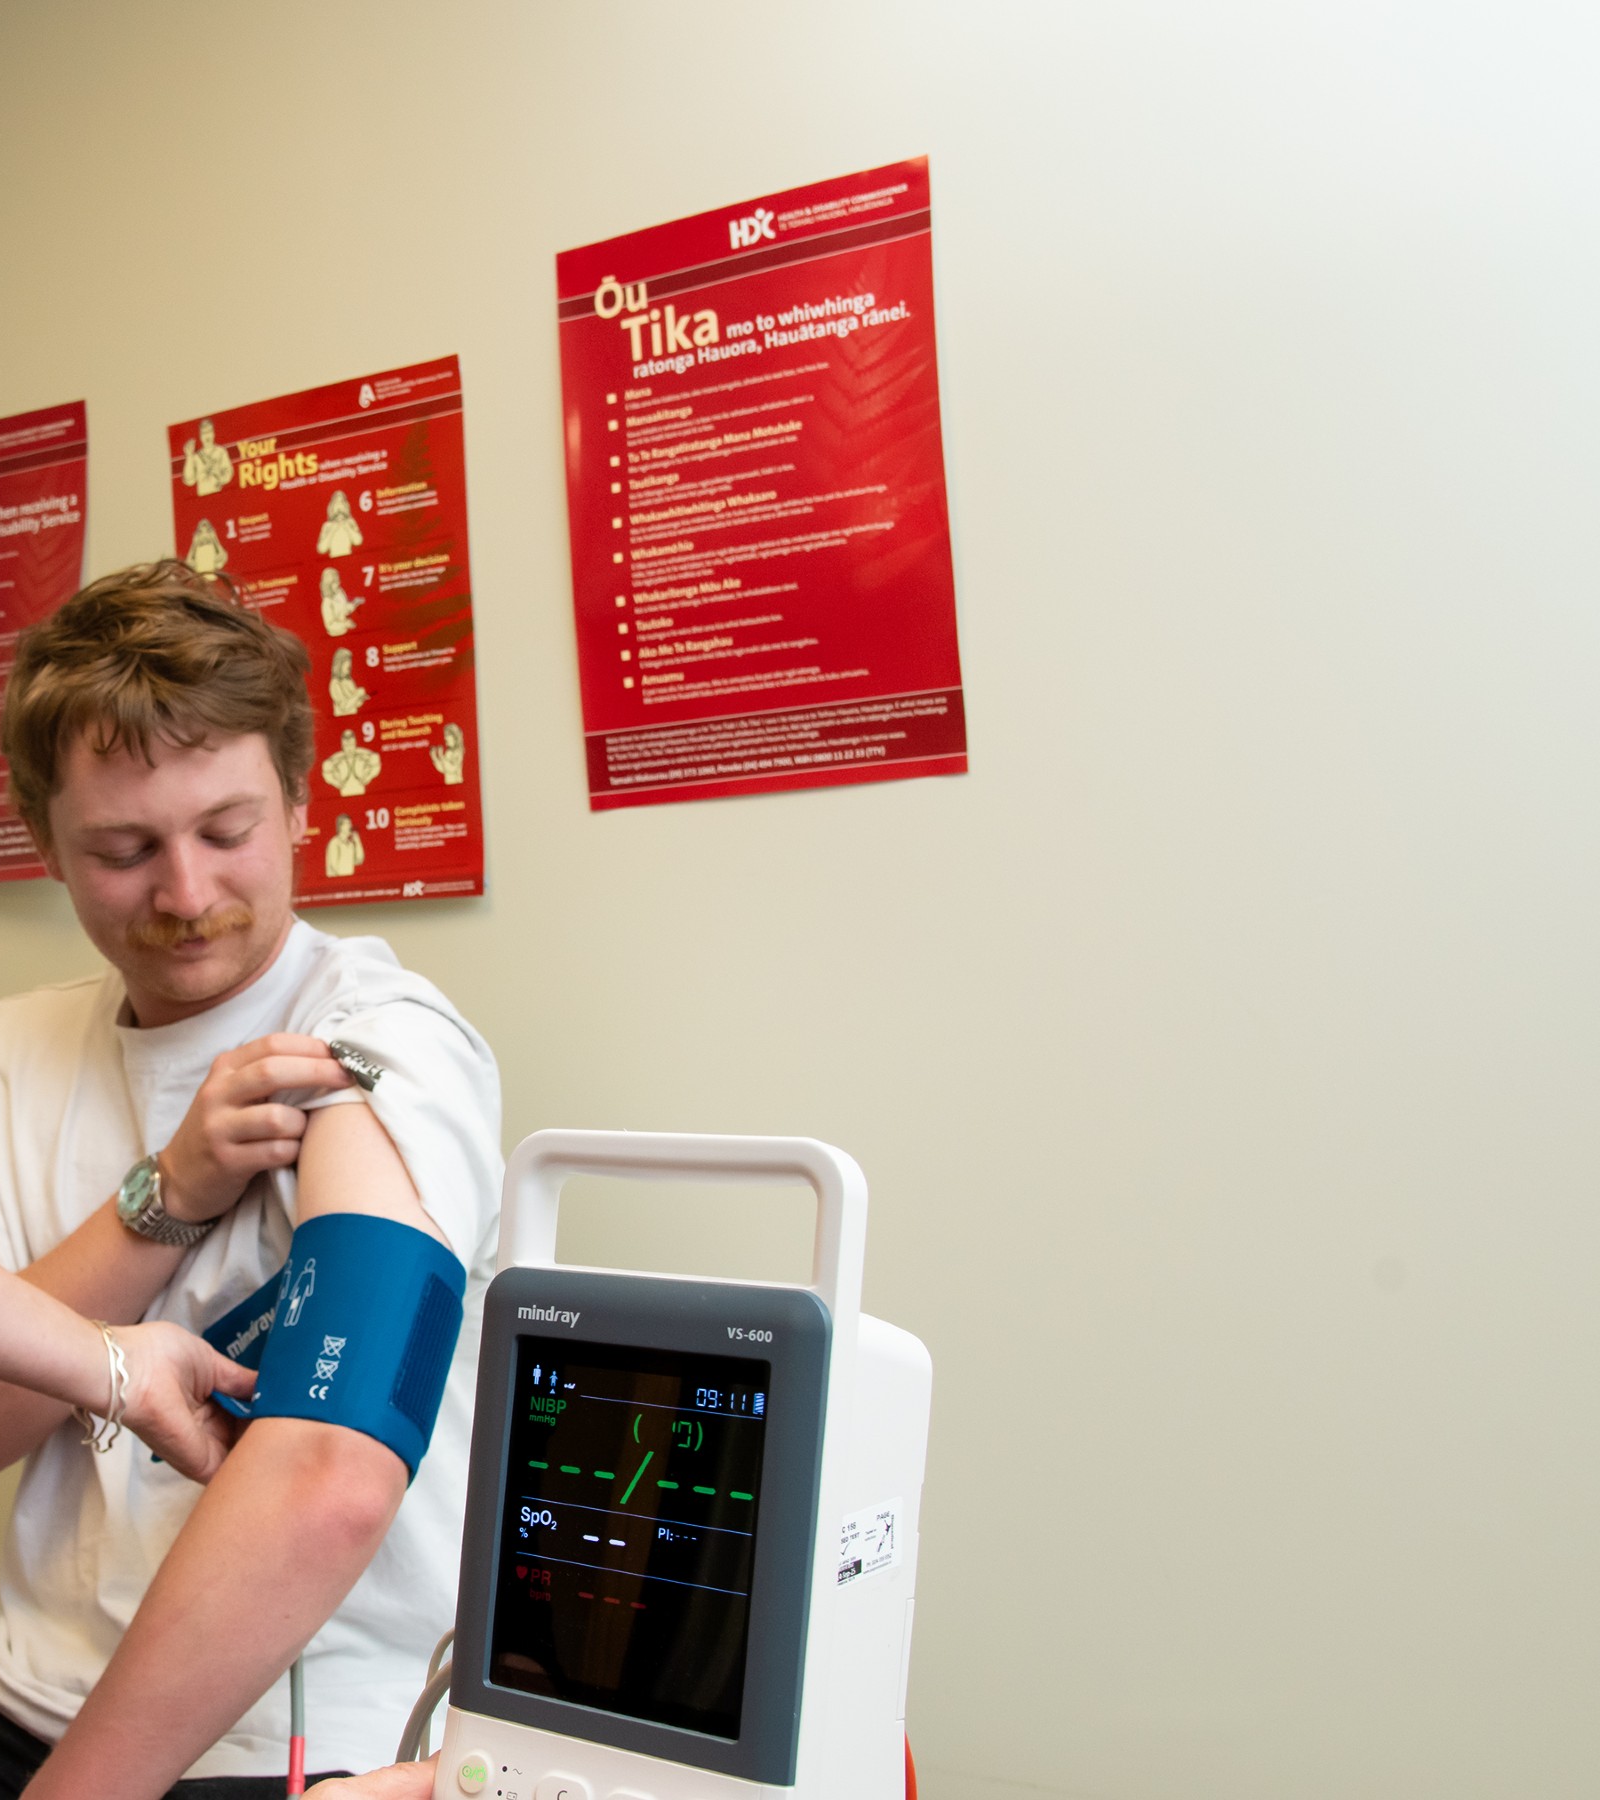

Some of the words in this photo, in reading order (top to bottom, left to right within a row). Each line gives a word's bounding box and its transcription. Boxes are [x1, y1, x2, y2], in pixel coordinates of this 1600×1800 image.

[594, 275, 648, 319] Ōu
[620, 304, 720, 362] Tika
[756, 314, 775, 332] to
[777, 292, 876, 327] whiwhinga
[633, 353, 695, 379] ratonga
[697, 339, 762, 365] Hauora,
[236, 437, 277, 461] Your
[238, 453, 318, 491] Rights
[19, 495, 69, 516] receiving
[69, 493, 78, 507] a
[359, 490, 373, 512] 6
[41, 510, 81, 529] Service
[225, 518, 237, 539] 1
[362, 565, 375, 587] 7
[366, 646, 380, 668] 8
[362, 721, 375, 743] 9
[365, 807, 390, 831] 10
[517, 1304, 581, 1329] mindray
[726, 1326, 773, 1343] VS-600
[530, 1396, 567, 1415] NIBP
[696, 1387, 747, 1411] 09:11
[528, 1413, 557, 1427] mmHg
[530, 1568, 551, 1586] PR
